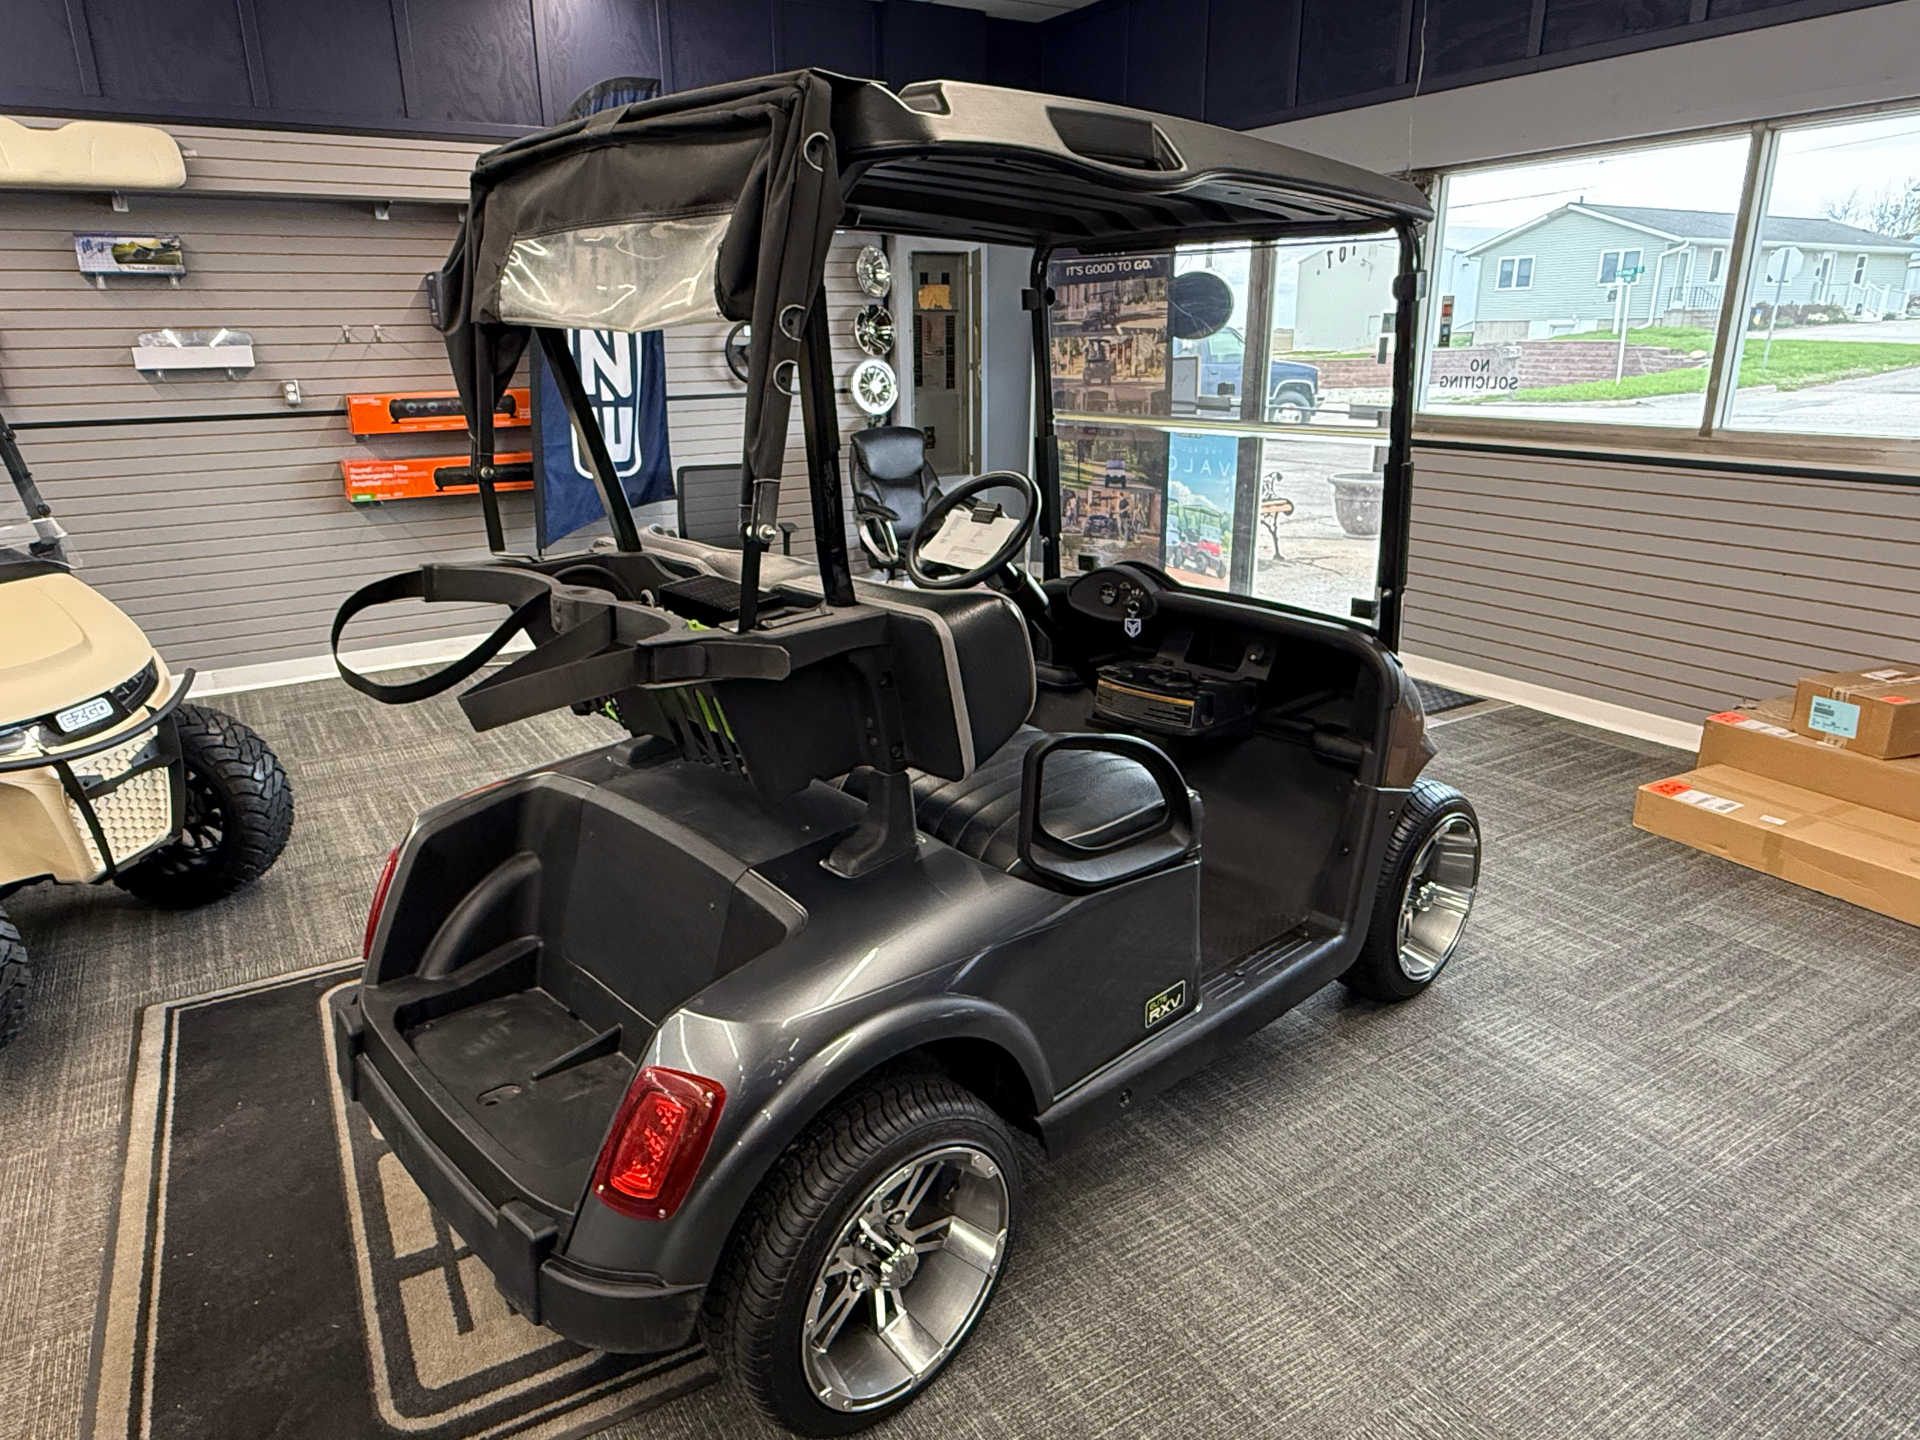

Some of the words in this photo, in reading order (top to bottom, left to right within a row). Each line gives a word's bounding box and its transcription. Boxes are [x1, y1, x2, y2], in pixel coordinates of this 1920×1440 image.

[1065, 265, 1084, 277] IT'S
[1085, 262, 1115, 275] GOOD
[1117, 260, 1132, 273] TO
[1133, 258, 1153, 271] GO.
[1148, 993, 1182, 1023] RXV
